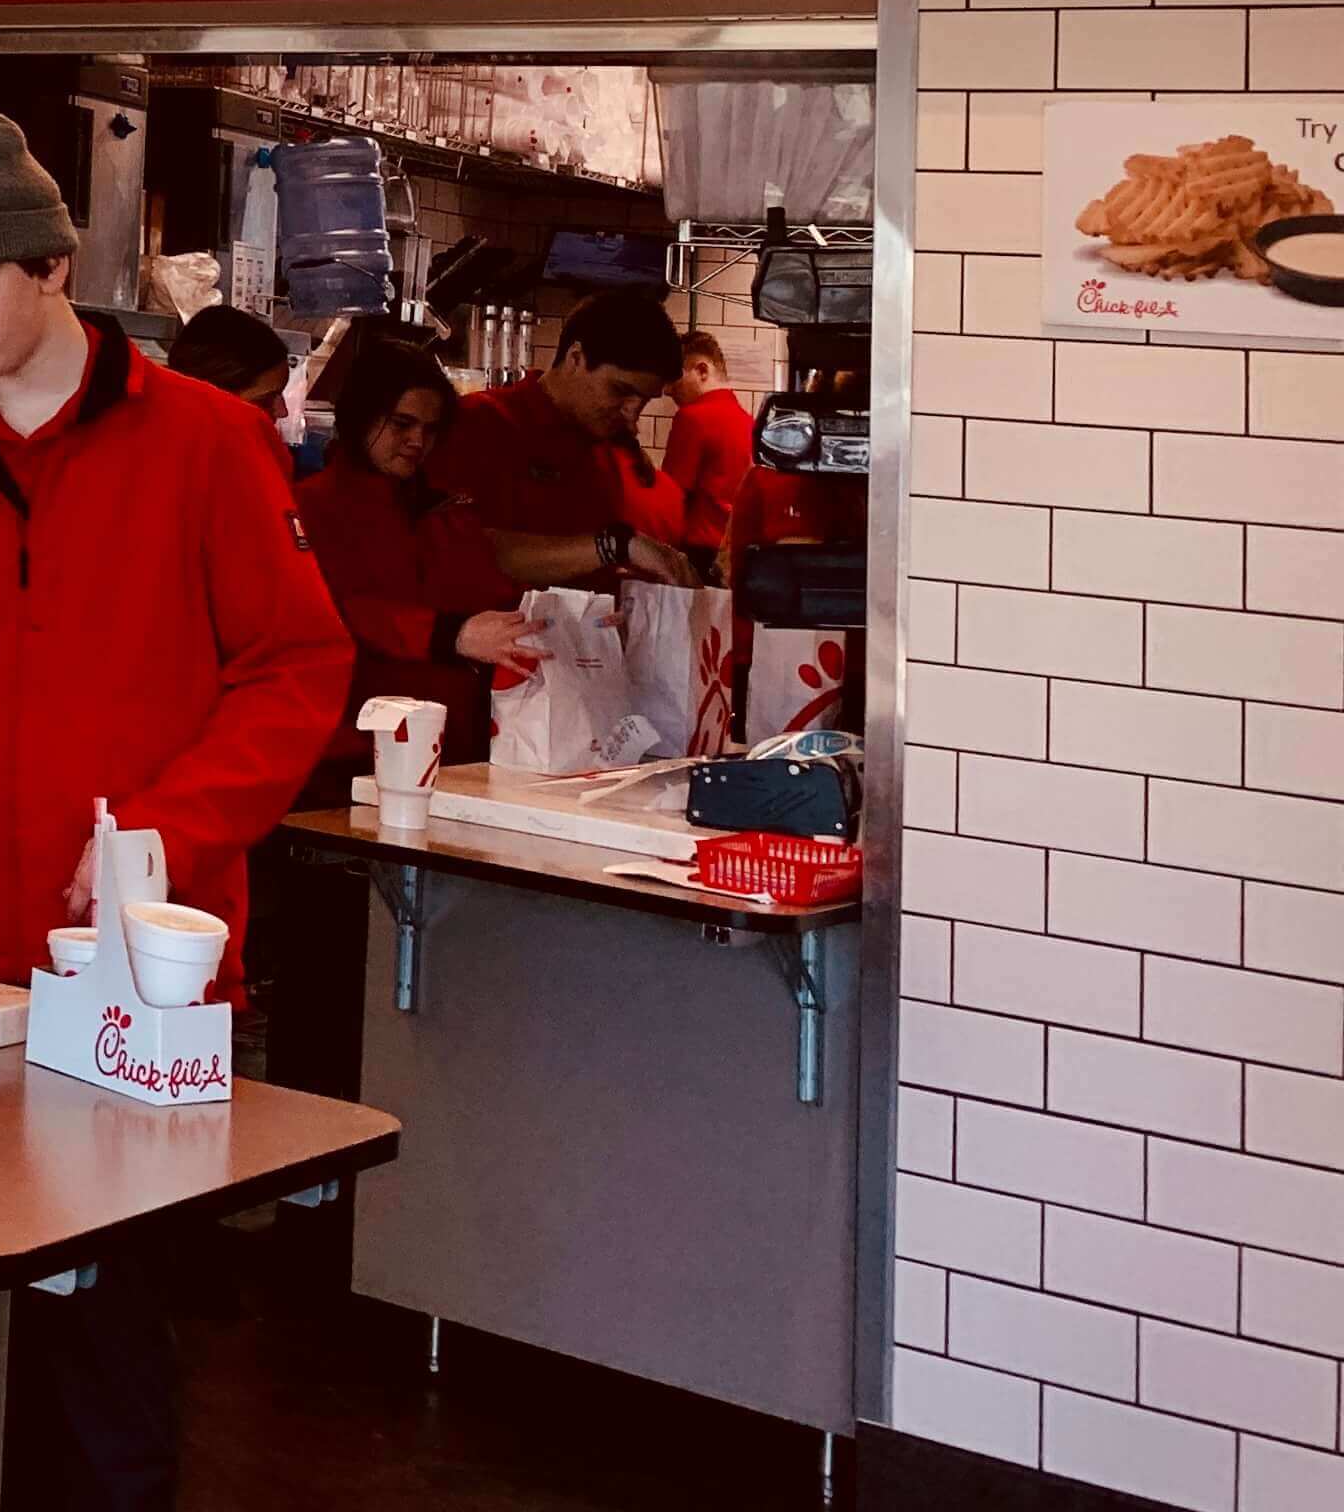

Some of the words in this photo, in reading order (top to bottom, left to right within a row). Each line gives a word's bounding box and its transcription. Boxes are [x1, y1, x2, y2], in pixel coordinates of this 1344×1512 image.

[1296, 117, 1336, 144] Try
[1077, 279, 1178, 318] Chick-fil-A
[95, 1006, 227, 1098] Chick-fil-A
